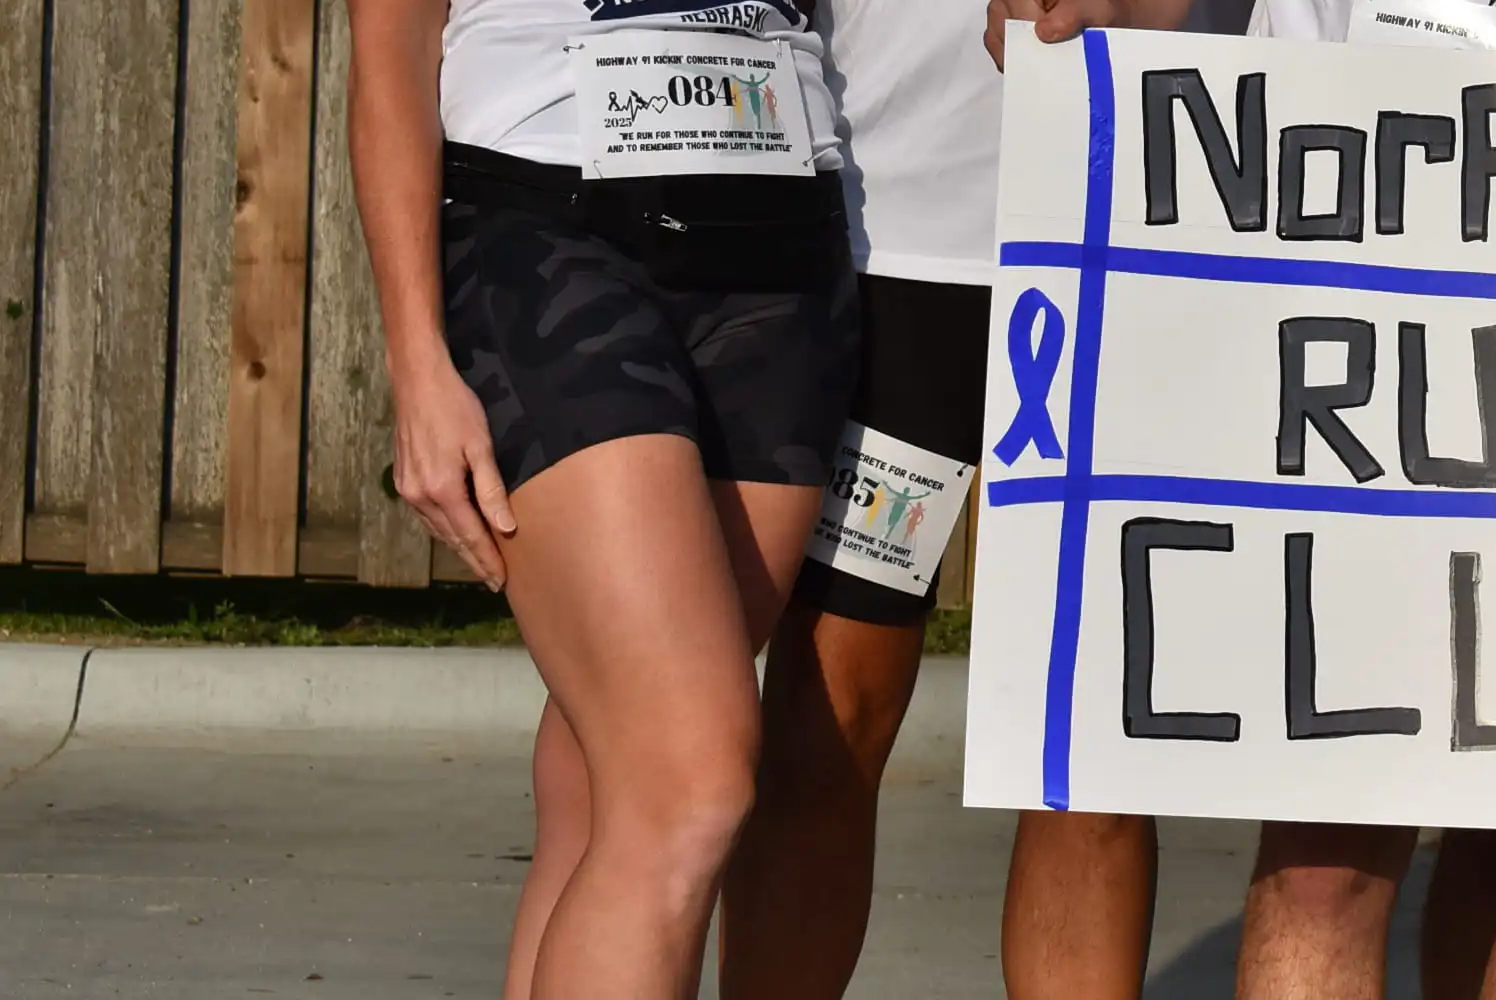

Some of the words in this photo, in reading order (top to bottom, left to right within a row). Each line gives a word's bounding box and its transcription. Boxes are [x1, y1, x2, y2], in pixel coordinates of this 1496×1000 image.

[680, 4, 769, 33] NEBRASK
[1376, 12, 1421, 30] HIGHWAY
[1424, 21, 1434, 32] 91
[596, 56, 638, 67] HIGHWAY
[642, 56, 651, 65] 91
[687, 56, 728, 66] CONCRETE
[731, 57, 745, 66] FOR
[748, 59, 776, 70] CANCER
[668, 75, 736, 107] 084
[604, 118, 633, 128] 2025
[637, 132, 653, 140] RUN
[656, 131, 671, 139] FOR
[674, 130, 698, 138] THOSE
[701, 130, 717, 138] WHO
[719, 131, 753, 139] CONTINUE
[755, 132, 764, 140] TO
[607, 145, 624, 153] AND
[626, 144, 637, 152] TO
[640, 143, 683, 152] REMEMBER
[686, 142, 710, 150] THOSE
[713, 142, 728, 150] WHO
[730, 142, 747, 150] LOST
[749, 143, 763, 151] THE
[842, 446, 887, 471] CONCRETE
[888, 465, 907, 478] FOR
[909, 472, 945, 491] CANCER
[829, 467, 880, 507] 85
[838, 525, 875, 545] CONTINUE
[878, 539, 888, 549] TO
[890, 544, 912, 557] FIGHT
[843, 538, 863, 553] LOST
[865, 546, 880, 559] THE
